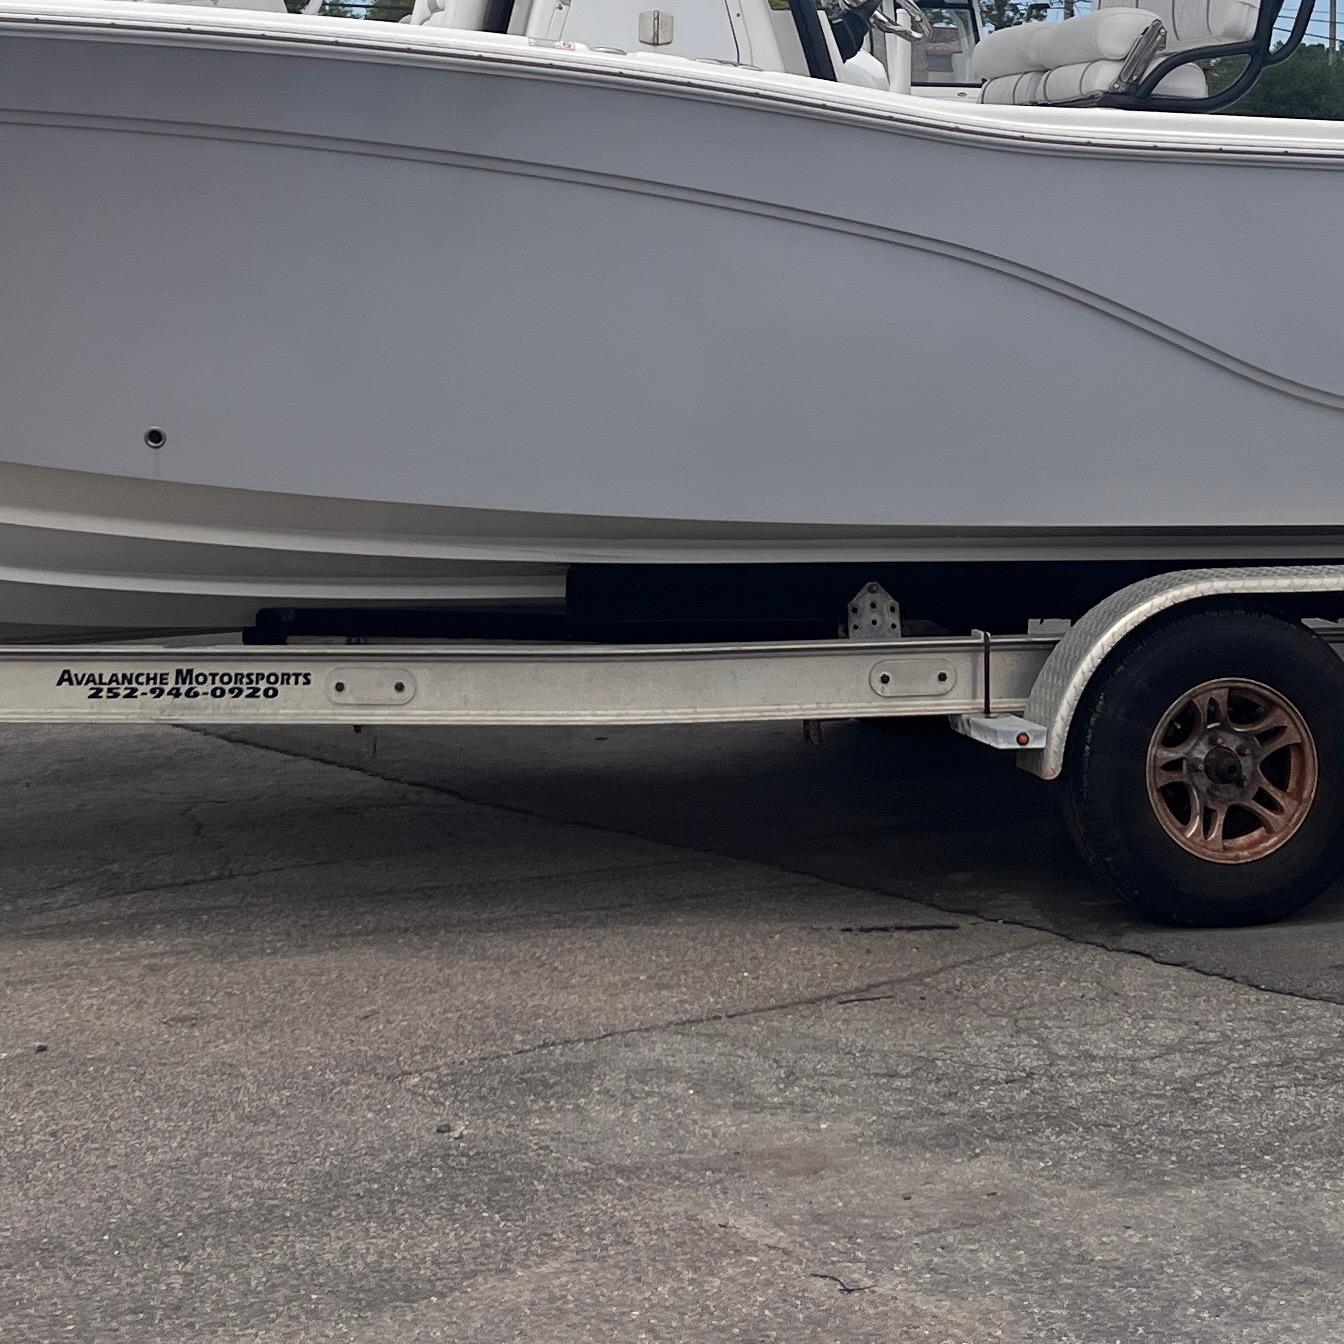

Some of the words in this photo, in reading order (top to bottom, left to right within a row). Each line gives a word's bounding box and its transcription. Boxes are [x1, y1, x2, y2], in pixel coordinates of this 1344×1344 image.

[57, 669, 169, 686] AVALANCHE
[174, 668, 312, 686] MOTORSPORTS
[87, 687, 279, 699] 252-946-0920
